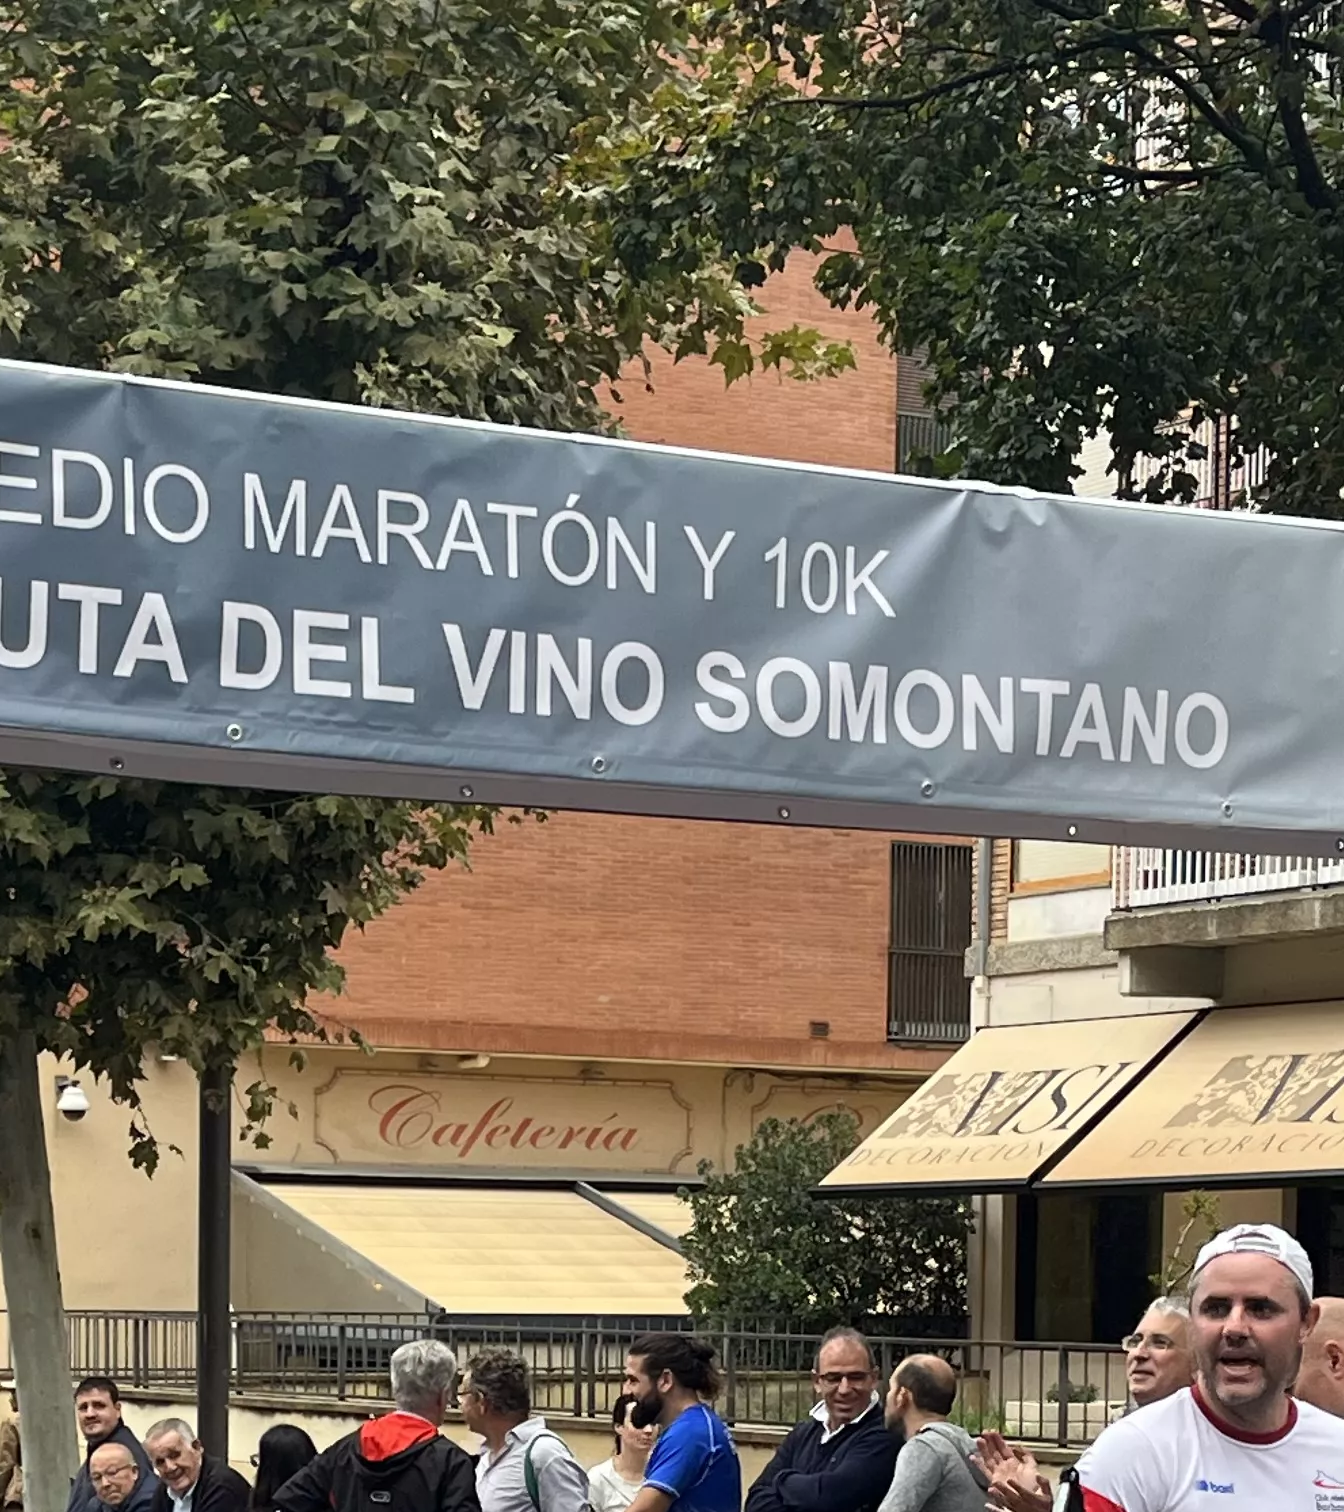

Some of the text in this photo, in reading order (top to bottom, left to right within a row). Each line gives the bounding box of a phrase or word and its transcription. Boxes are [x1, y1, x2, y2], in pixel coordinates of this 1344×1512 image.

[244, 473, 656, 594] MARATÓN
[683, 525, 736, 600] Y
[763, 536, 897, 618] 10K
[219, 600, 415, 704] DEL
[441, 623, 665, 726] VINO
[694, 651, 1229, 769] SOMONTANO
[368, 1084, 639, 1158] Cafetería
